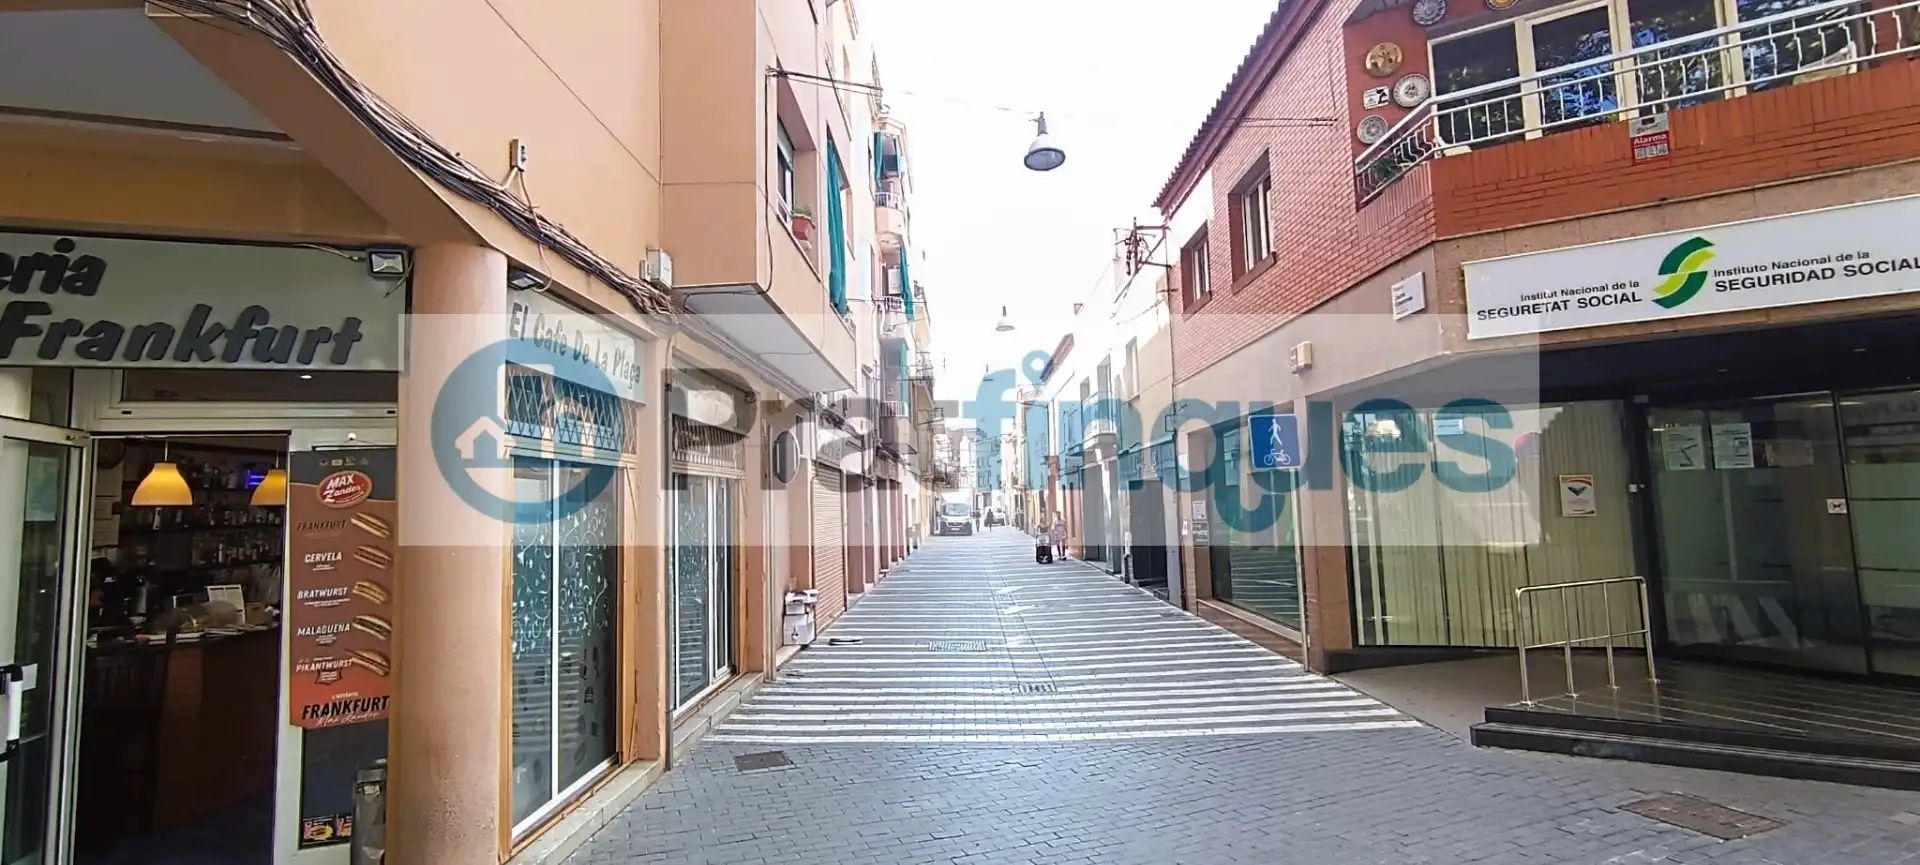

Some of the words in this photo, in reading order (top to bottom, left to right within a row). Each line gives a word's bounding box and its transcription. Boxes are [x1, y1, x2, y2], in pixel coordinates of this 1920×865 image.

[1634, 134, 1667, 144] Alarma
[1714, 264, 1768, 277] Instituto
[1772, 255, 1831, 270] Nacional
[1836, 252, 1853, 263] de
[1858, 250, 1870, 260] la
[1715, 267, 1836, 293] SEGURIDAD
[1844, 256, 1920, 277] SOCIAL
[1520, 291, 1558, 303] Institut
[1561, 283, 1609, 299] Nacional
[1612, 281, 1627, 291] de
[1629, 279, 1640, 289] la
[1477, 299, 1570, 322] SEGURETAT
[1578, 291, 1642, 310] SOCIAL
[0, 300, 363, 366] Frankfurt
[509, 301, 529, 342] El
[573, 329, 591, 364] De
[613, 347, 641, 390] Plaça
[326, 473, 355, 490] MAX
[323, 485, 362, 503] Zander
[297, 519, 348, 532] FRANKFURT
[304, 551, 343, 564] CERVELA
[297, 587, 349, 600] BRATWURST
[296, 659, 354, 673] PIKANTWURST
[302, 695, 390, 720] FRANKFURT
